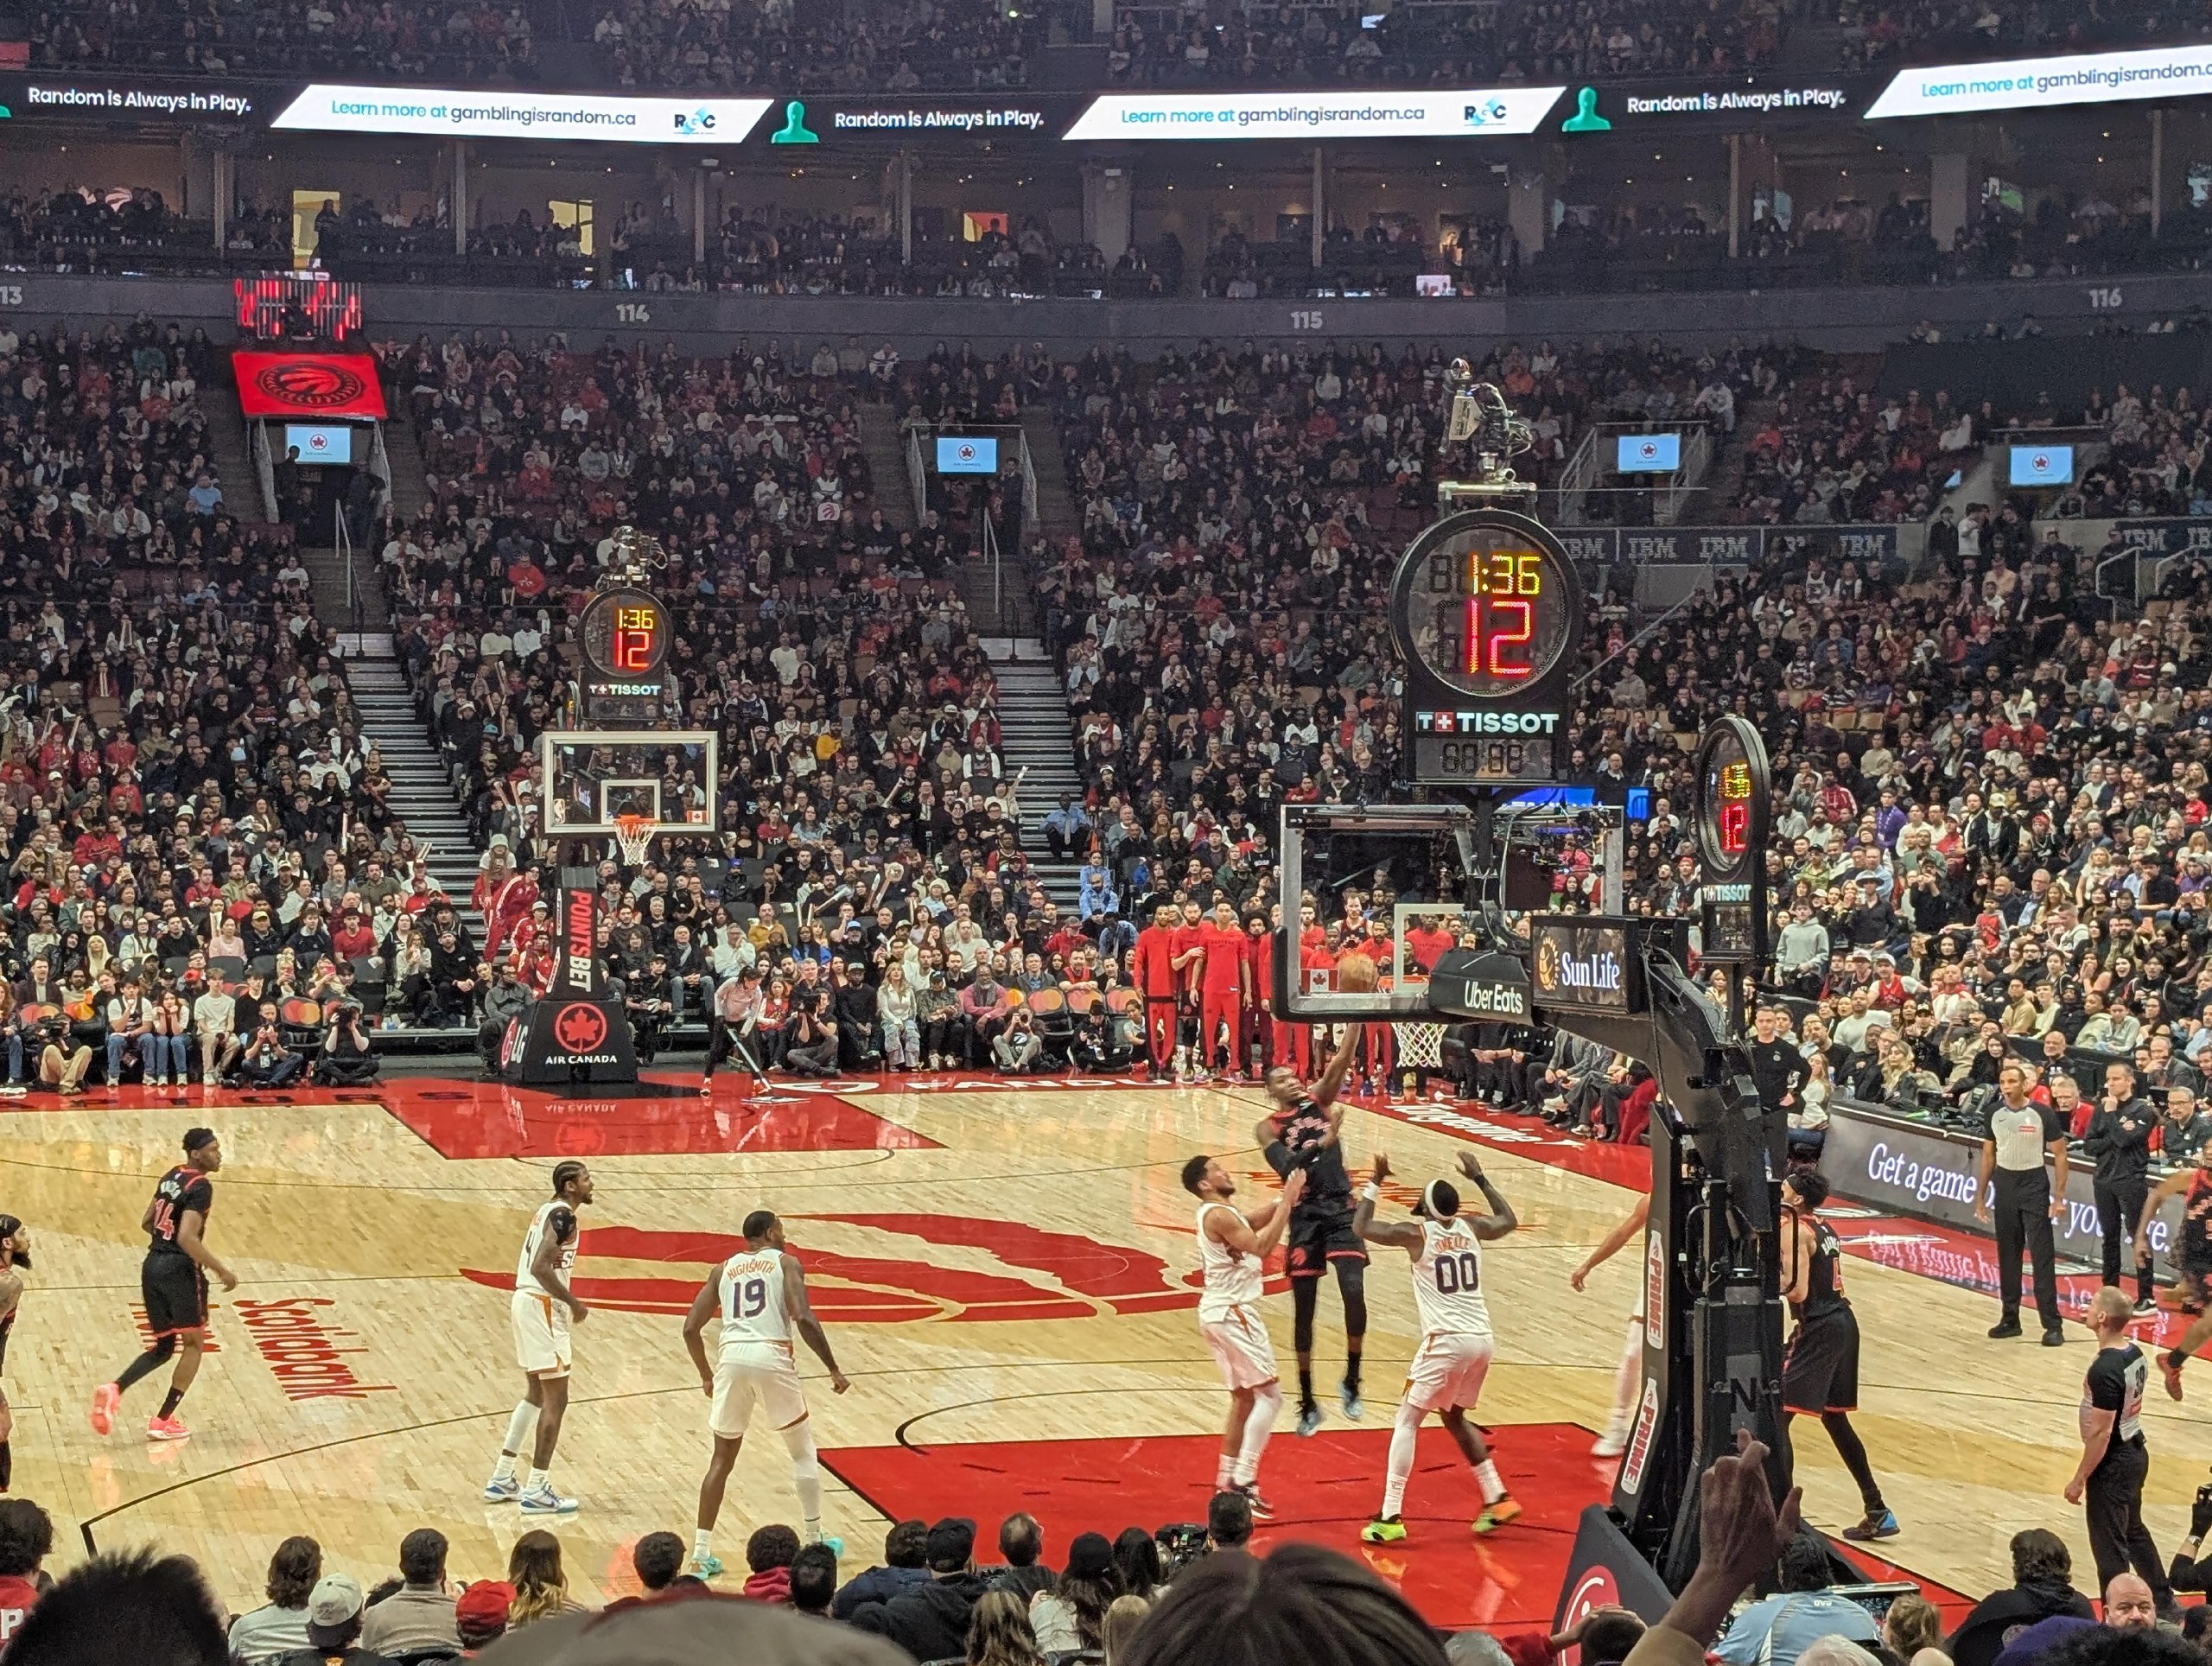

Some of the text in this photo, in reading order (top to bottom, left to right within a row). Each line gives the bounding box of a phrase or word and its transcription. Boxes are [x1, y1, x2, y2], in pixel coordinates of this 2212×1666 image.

[1922, 82, 1967, 98] Learn
[1969, 79, 2013, 93] more
[2017, 74, 2034, 89] at
[29, 86, 251, 116] Random is Always in Play.
[332, 99, 636, 126] Learn more at gamblingisrandom.ca
[1628, 88, 1847, 113] Random is Always in Play.
[835, 109, 1045, 130] Random is Always in Play.
[1122, 105, 1425, 126] Learn more at gamblingisrandom.ca
[2089, 288, 2122, 308] 116
[616, 303, 650, 321] 114
[1290, 311, 1323, 328] 115
[1628, 537, 1676, 558] IBM
[1699, 537, 1749, 558] IBM
[1472, 554, 1541, 595] 1:36
[618, 607, 655, 630] 1:36
[617, 630, 650, 667] 12
[1471, 599, 1532, 674] 12
[608, 684, 662, 696] TISSOT
[1456, 712, 1560, 734] TISSOT
[1716, 884, 1752, 902] TISSOT
[569, 889, 592, 992] POINTSBET
[1560, 951, 1621, 990] Sun Life
[1464, 979, 1523, 1014] Uber Eats
[545, 1055, 618, 1065] AIR CANADA
[1868, 1142, 1906, 1186] Get
[1905, 1161, 1916, 1190] a
[1916, 1166, 1978, 1204] game
[2064, 1199, 2105, 1239] you
[1434, 1253, 1478, 1294] 00
[733, 1278, 766, 1319] 19
[1648, 1256, 1662, 1339] PRIME
[232, 1297, 399, 1402] Scotiabank
[1624, 1404, 1656, 1485] PRIME
